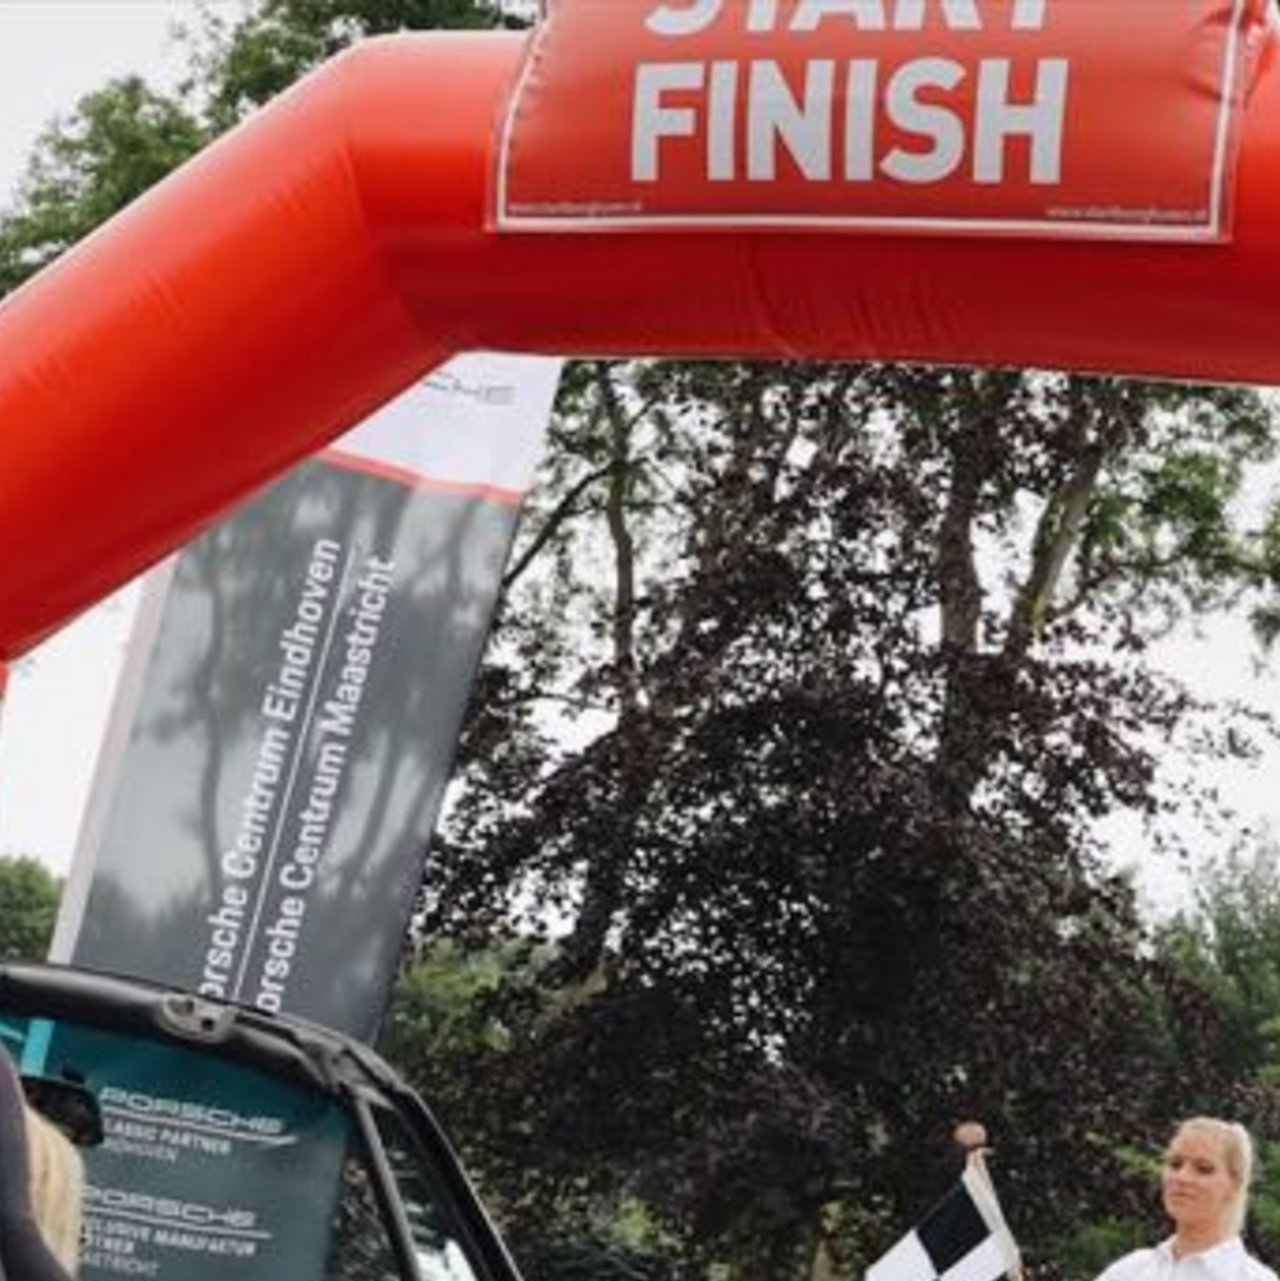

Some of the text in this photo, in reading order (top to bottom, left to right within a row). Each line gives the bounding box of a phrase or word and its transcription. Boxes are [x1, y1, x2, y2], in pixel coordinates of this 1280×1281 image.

[630, 58, 1070, 185] FINISH
[199, 537, 342, 999] orsche Centrum Eindhoven
[255, 556, 397, 1014] orsche Centrum Maastricht
[99, 1085, 286, 1136] PORSCHE
